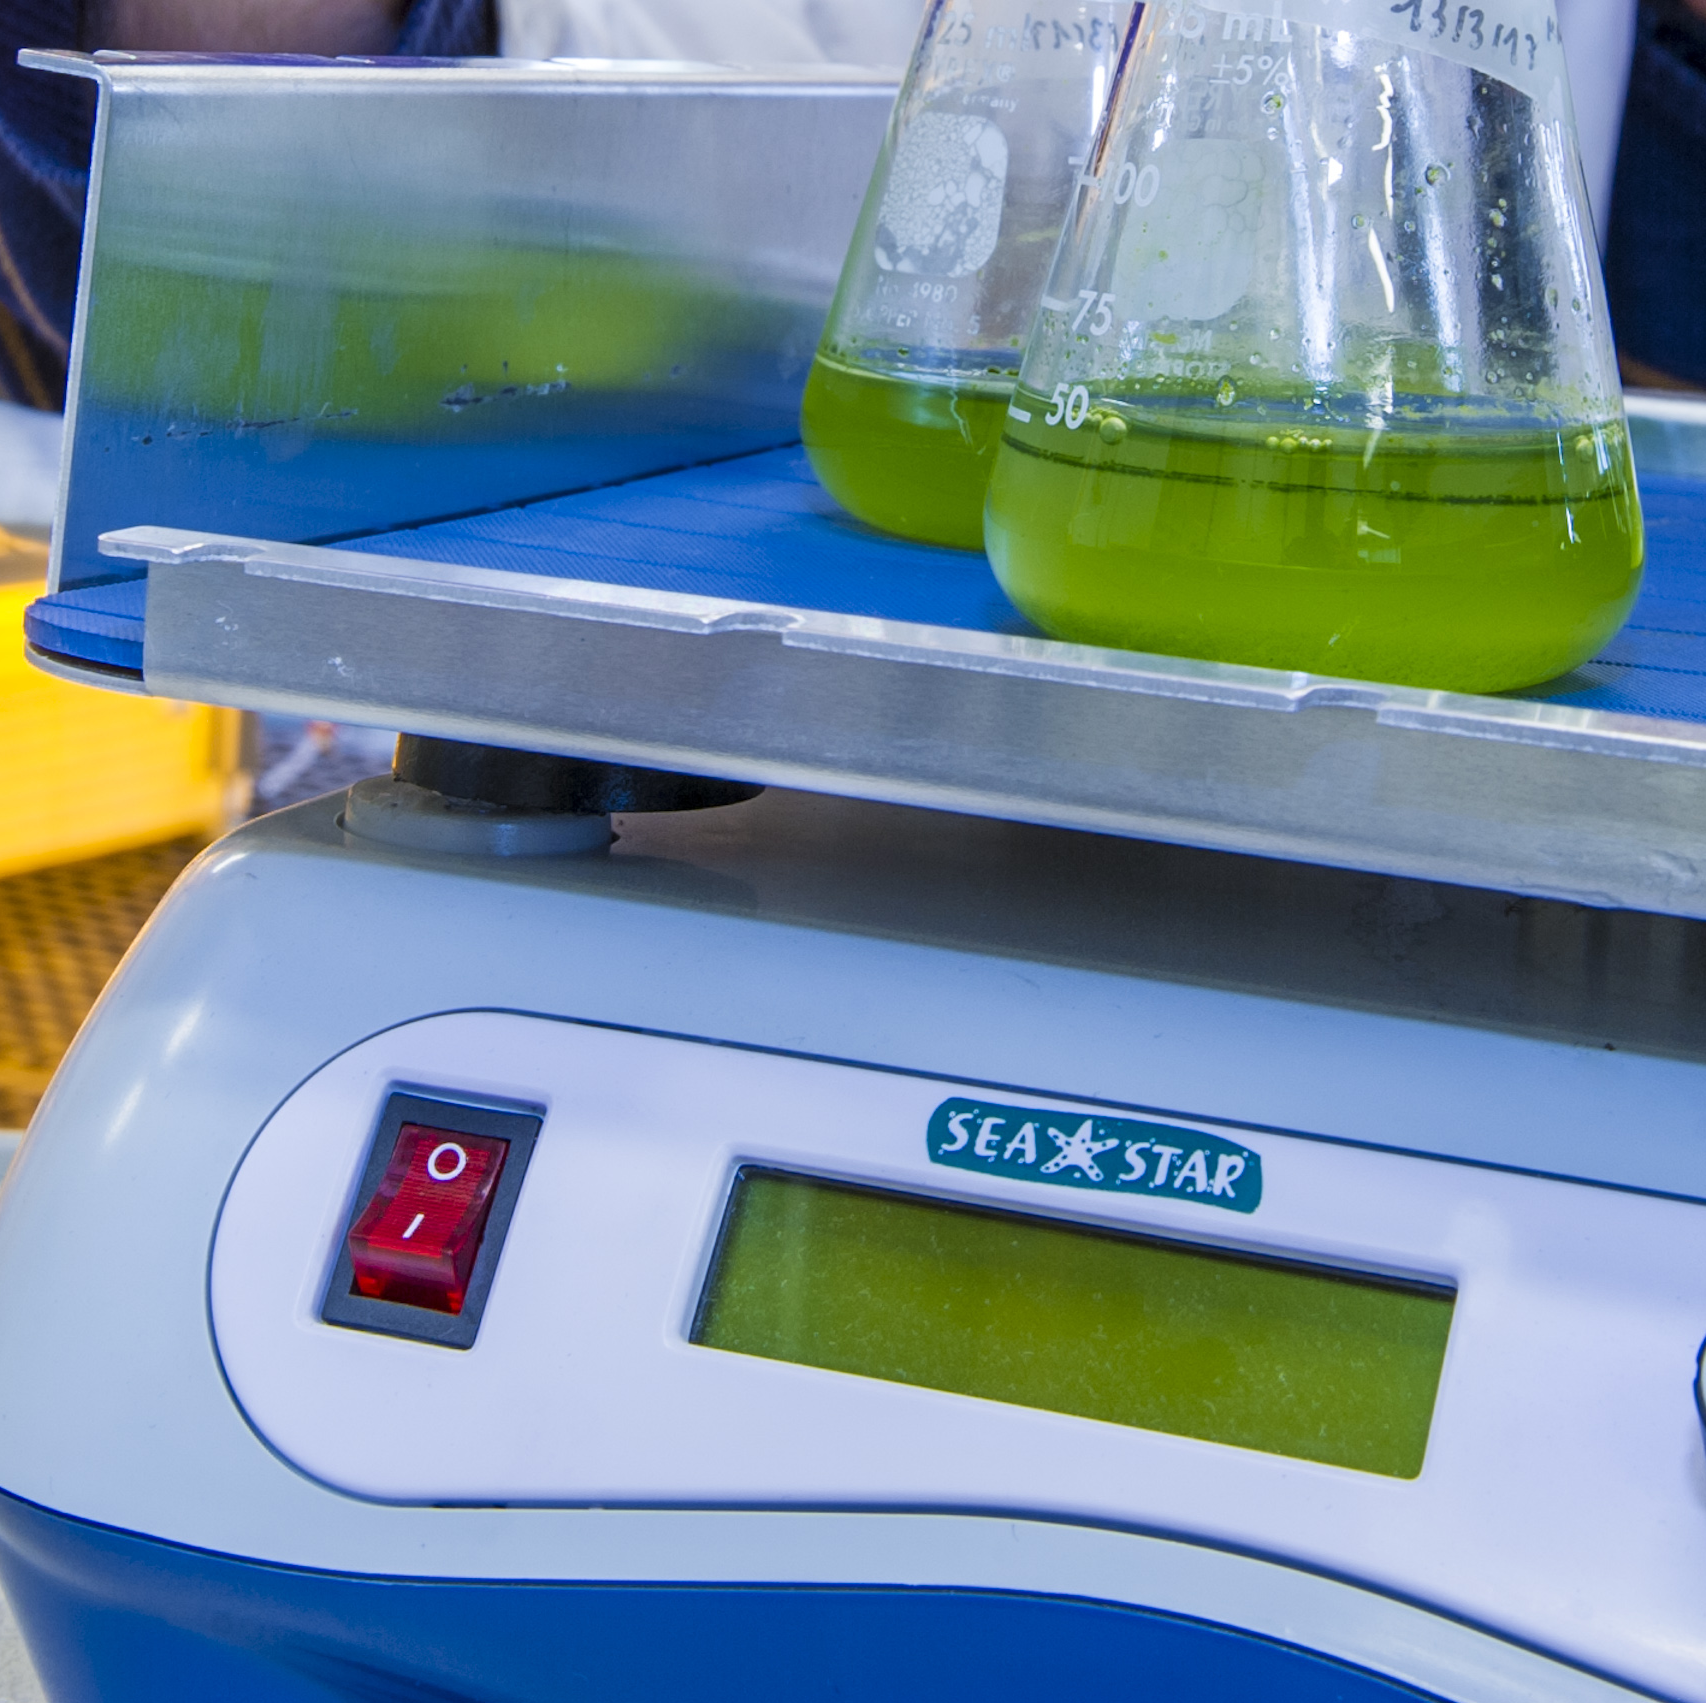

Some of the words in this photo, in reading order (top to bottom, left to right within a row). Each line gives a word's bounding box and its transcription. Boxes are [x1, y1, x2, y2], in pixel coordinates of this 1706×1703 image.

[1209, 54, 1289, 86] ±5%
[1100, 161, 1160, 207] 100
[1071, 289, 1116, 336] 75
[1044, 382, 1089, 430] 50
[941, 1112, 1037, 1164] SEA
[1118, 1141, 1246, 1198] STAR
